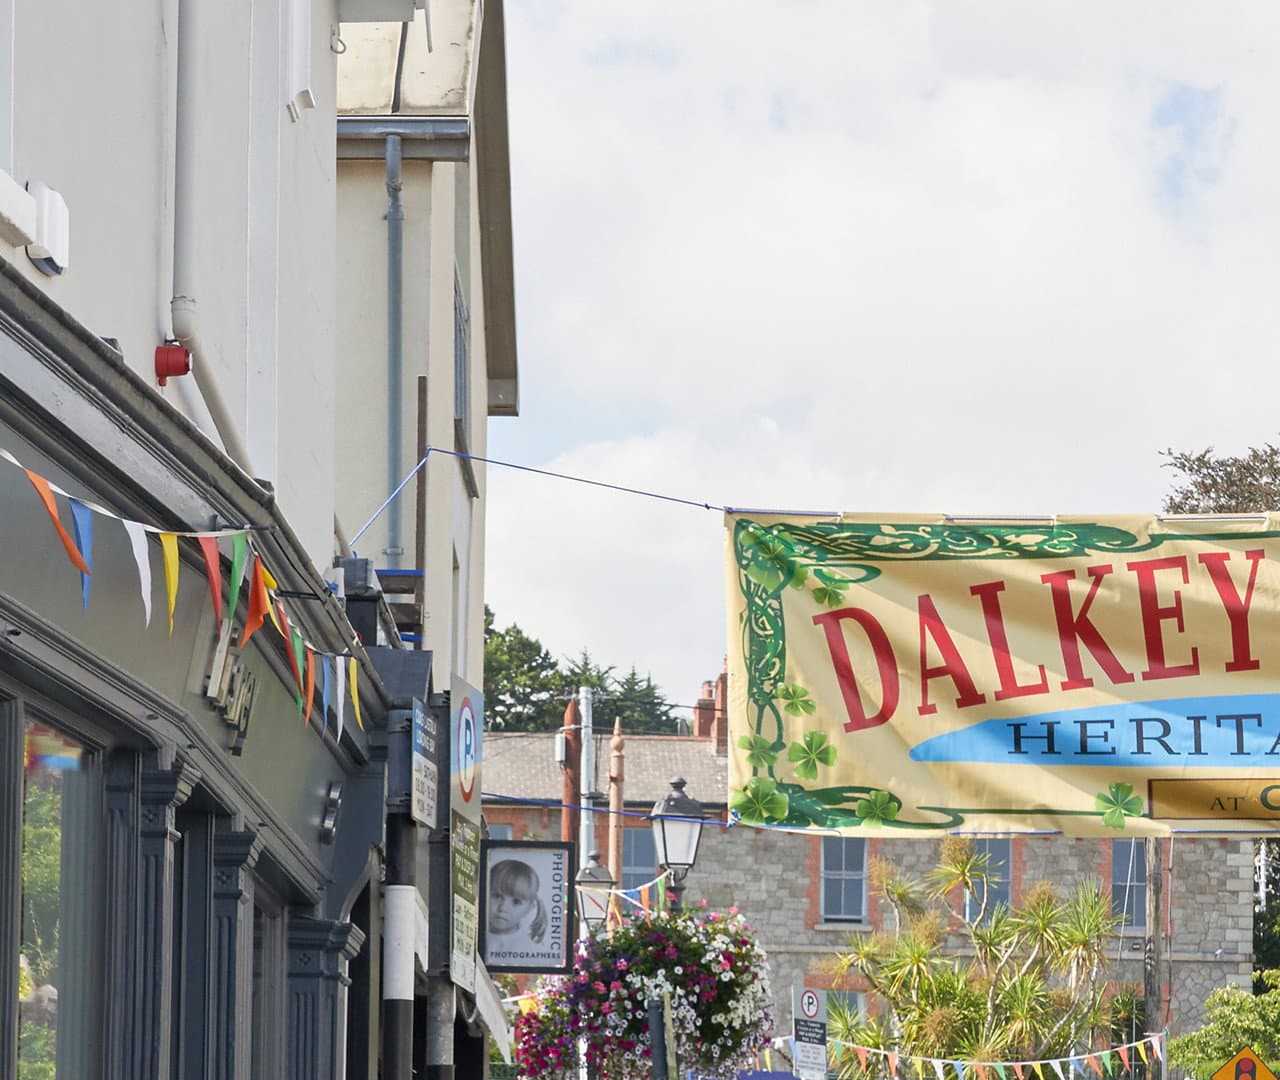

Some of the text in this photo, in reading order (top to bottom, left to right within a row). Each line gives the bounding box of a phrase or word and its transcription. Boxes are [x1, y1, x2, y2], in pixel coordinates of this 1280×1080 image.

[812, 549, 1265, 733] DALKEY
[1209, 795, 1245, 812] AT
[551, 853, 563, 951] PHOTOGENIC
[489, 951, 561, 960] PHOTOGRAPHERS
